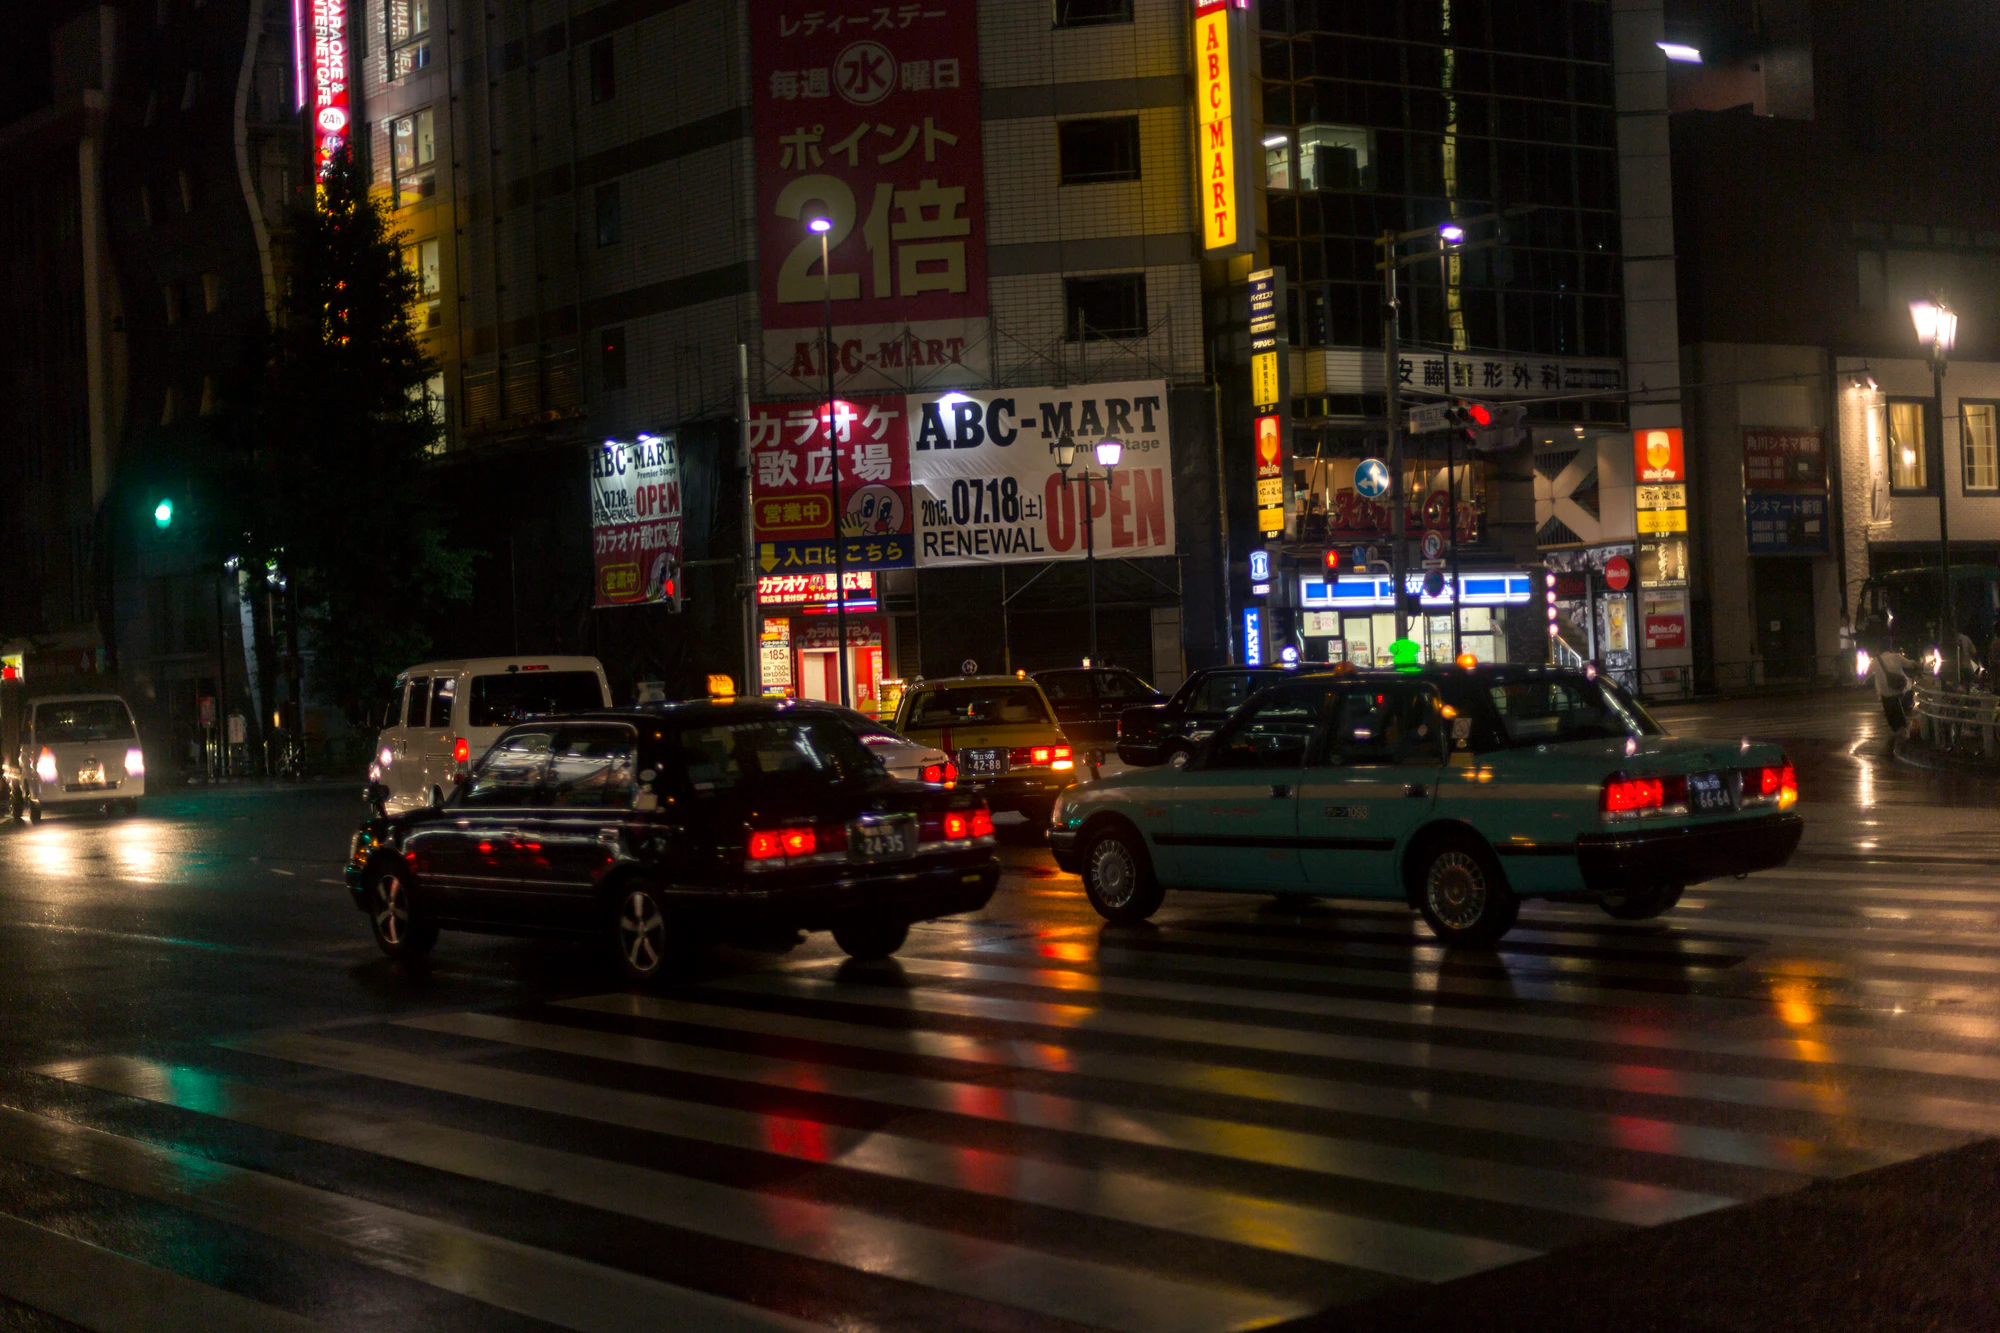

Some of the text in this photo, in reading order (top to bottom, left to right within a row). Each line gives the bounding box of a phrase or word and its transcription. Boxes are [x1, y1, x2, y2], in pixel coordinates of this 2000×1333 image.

[779, 4, 947, 38] レディースデー
[316, 66, 331, 106] CAFE
[322, 112, 342, 125] 24h
[1206, 22, 1228, 239] ABC-MART
[779, 116, 959, 171] ポイント
[774, 173, 972, 304] 2倍
[790, 337, 965, 378] ABC-MART
[750, 404, 900, 448] カラオケ
[916, 396, 1161, 451] ABC-MART
[592, 440, 676, 479] ABC-MART
[757, 443, 893, 488] 歌広場
[635, 480, 680, 518] OPEN
[763, 502, 821, 525] 営業中
[1044, 468, 1167, 553] OPEN
[596, 520, 681, 555] カラオケ歌広場
[923, 527, 1044, 558] RENEWAL
[606, 570, 638, 590] 営業中
[759, 574, 809, 594] カラオケ
[973, 759, 1001, 771] 42-88
